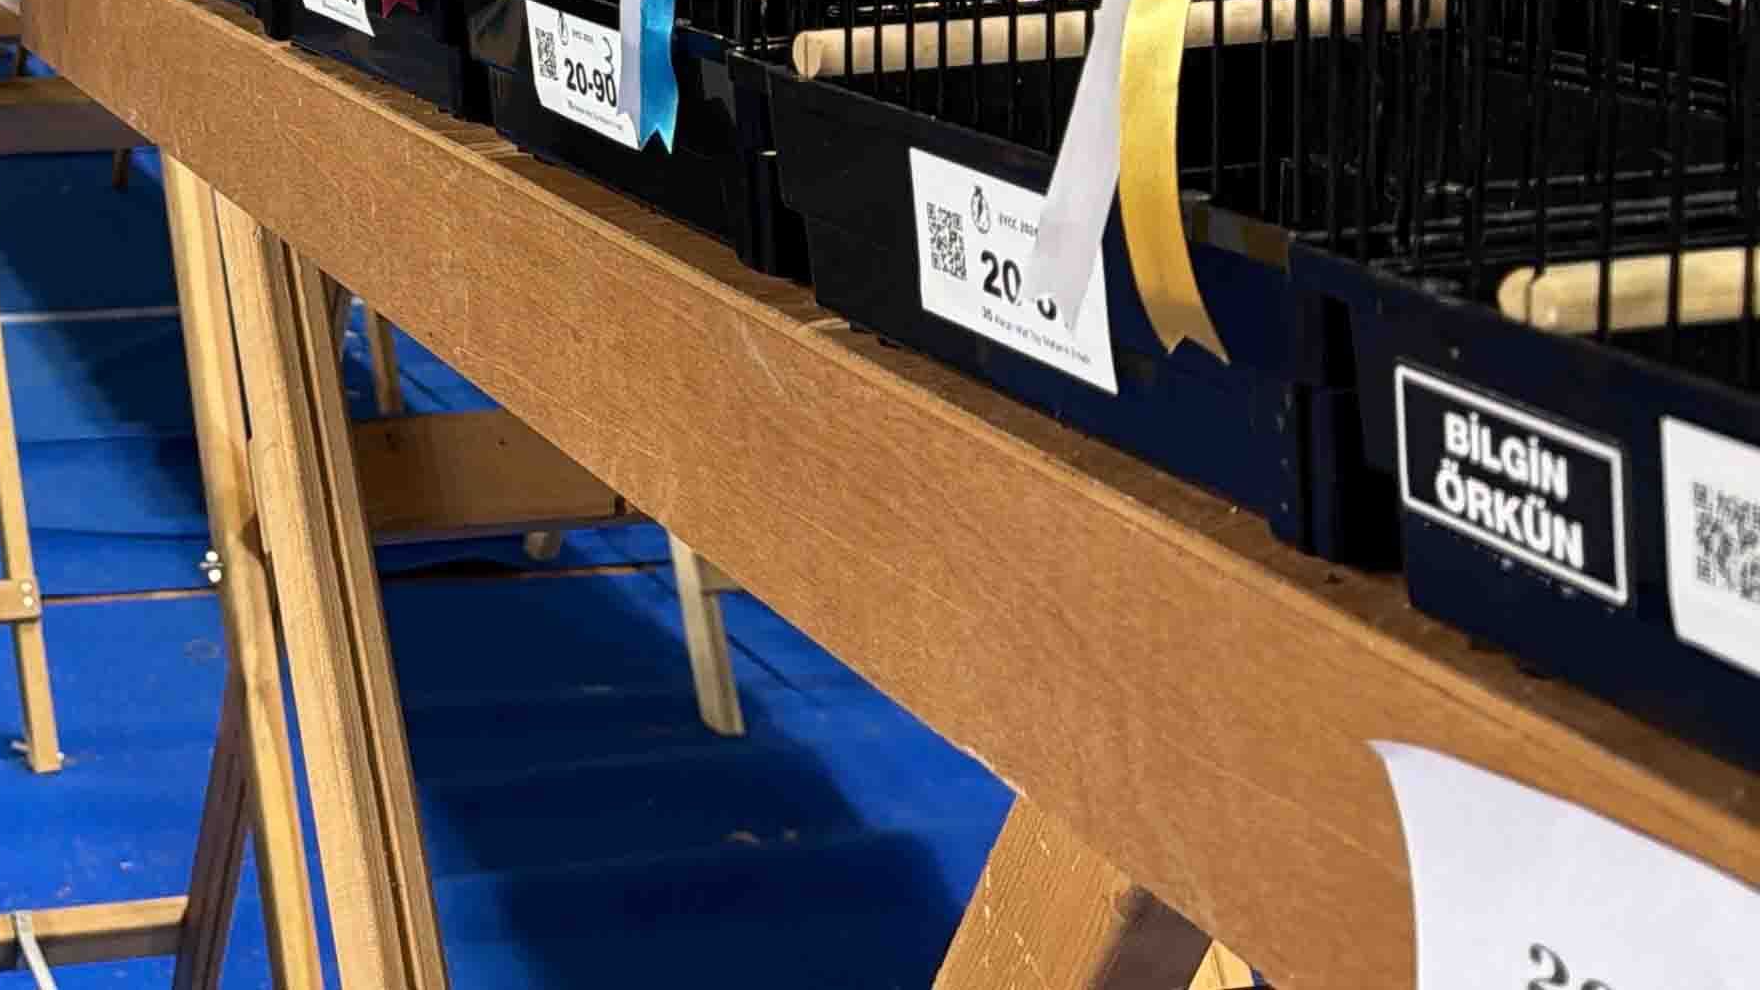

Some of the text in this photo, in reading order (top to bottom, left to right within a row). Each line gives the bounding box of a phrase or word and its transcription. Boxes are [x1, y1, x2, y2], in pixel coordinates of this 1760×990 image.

[563, 57, 618, 108] 20-90
[1443, 410, 1569, 502] BİLGİN
[1435, 457, 1585, 570] ÖRKÜN
